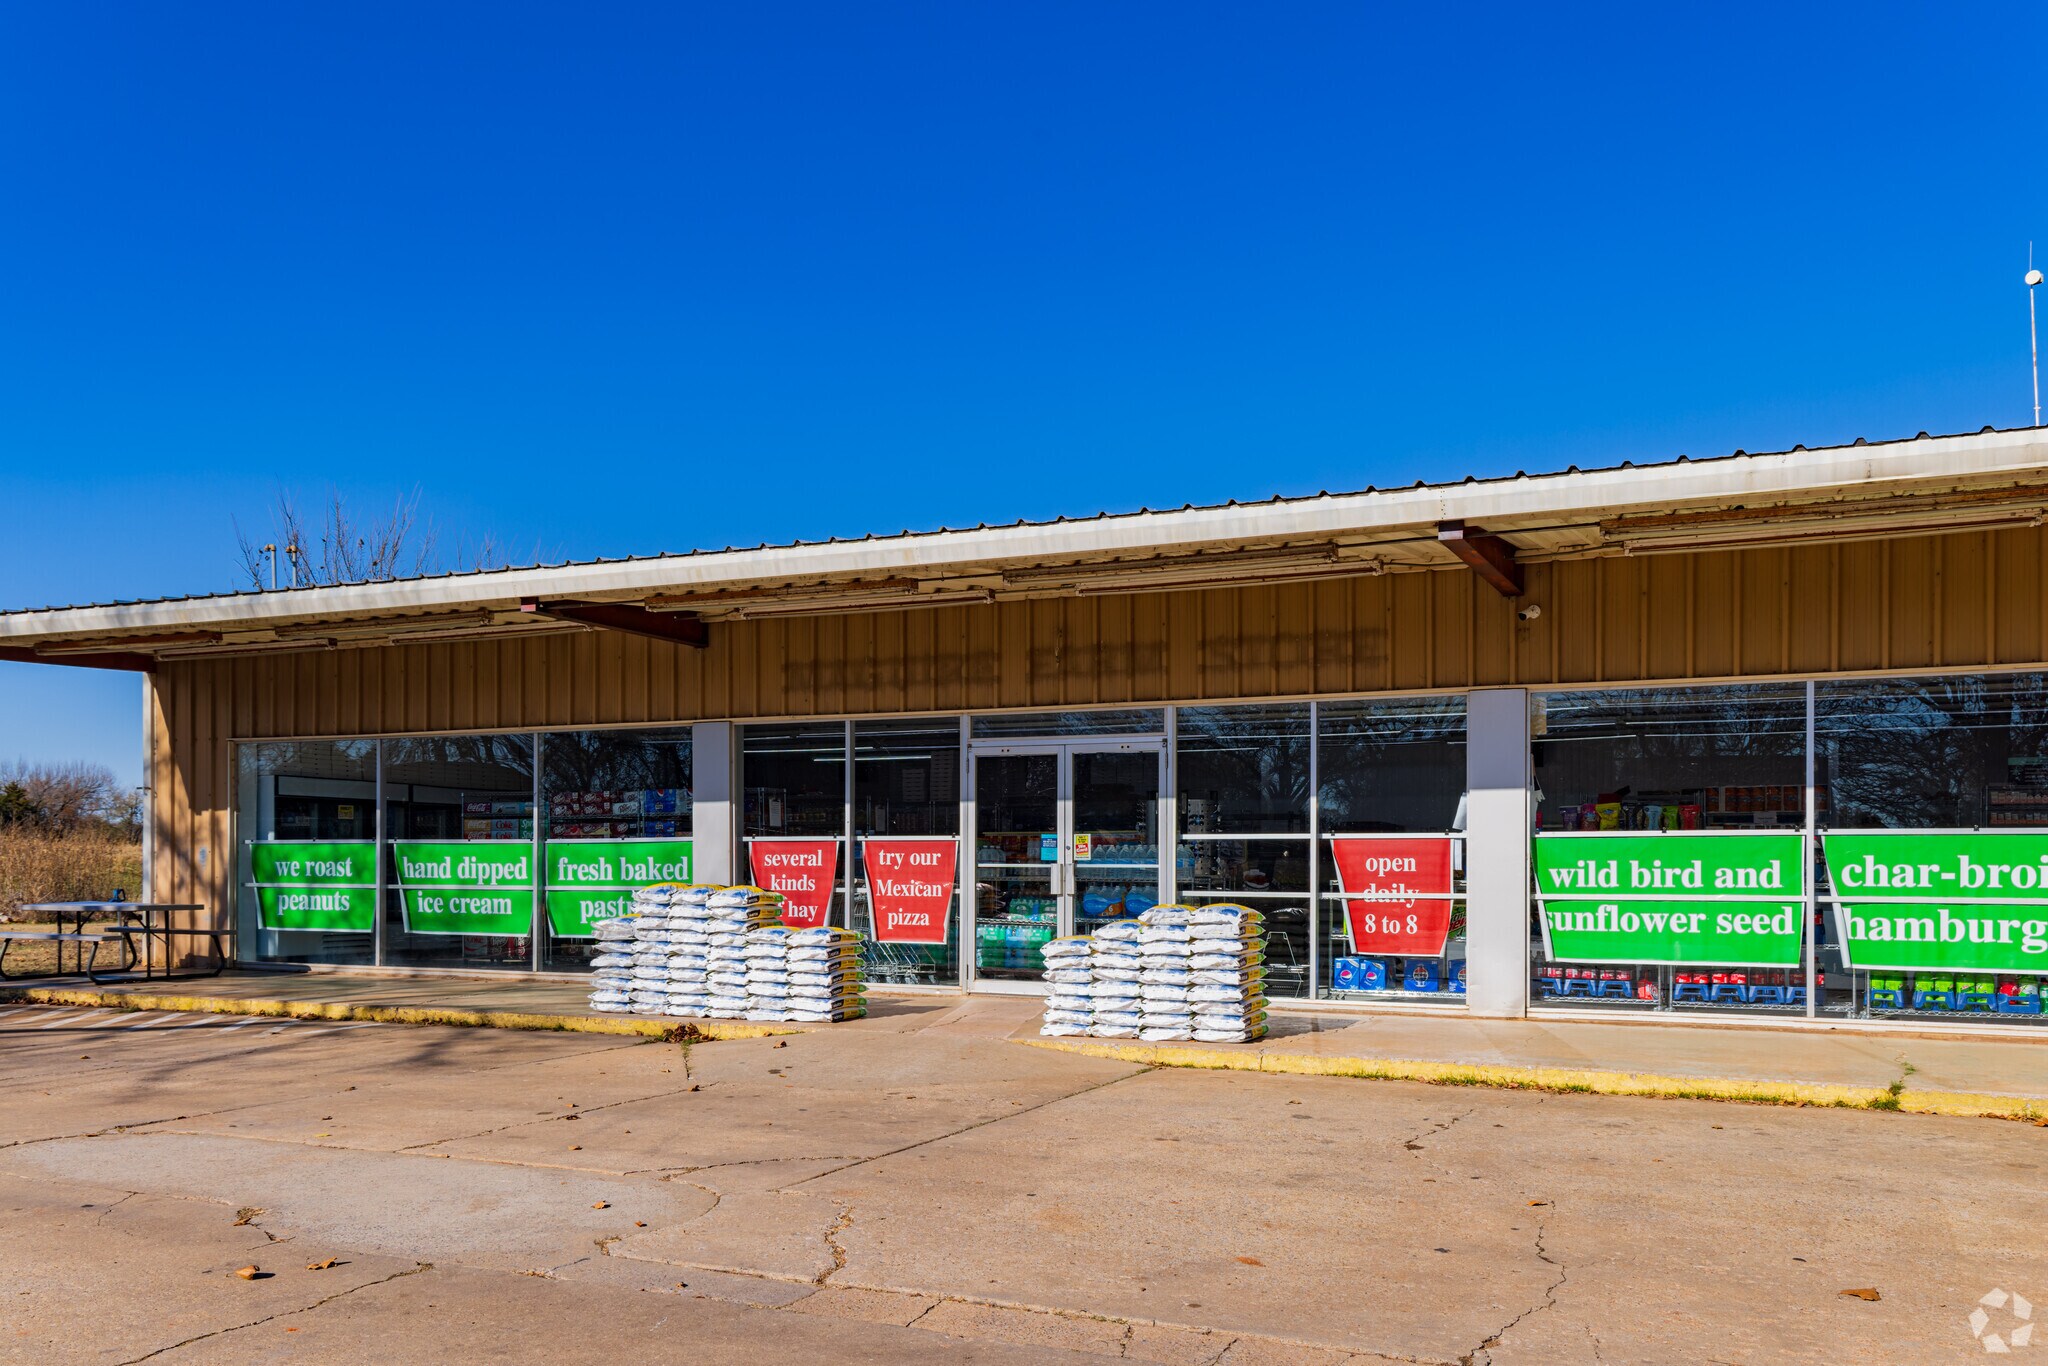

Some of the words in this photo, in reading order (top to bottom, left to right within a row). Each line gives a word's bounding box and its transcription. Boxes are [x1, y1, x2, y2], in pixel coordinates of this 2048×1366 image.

[276, 861, 300, 877] we
[305, 856, 352, 877] roast
[557, 857, 613, 881] fresh
[620, 856, 689, 881] baked
[764, 849, 823, 867] several
[878, 850, 905, 870] try
[910, 853, 941, 866] our
[1365, 857, 1417, 876] open
[403, 856, 452, 879] hand
[457, 856, 528, 885] dipped
[1548, 860, 1619, 888] wild
[1629, 860, 1704, 888] bird
[1714, 860, 1783, 889] and
[770, 874, 816, 892] kinds
[876, 879, 943, 897] Mexican
[277, 891, 350, 915] peanuts
[417, 891, 443, 913] ice
[449, 898, 512, 915] cream
[1363, 883, 1420, 908] daily
[788, 901, 818, 922] hay
[887, 908, 930, 929] pizza
[1716, 906, 1795, 935] seed
[1365, 913, 1376, 934] 8
[1382, 916, 1401, 933] to
[1406, 914, 1418, 934] 8
